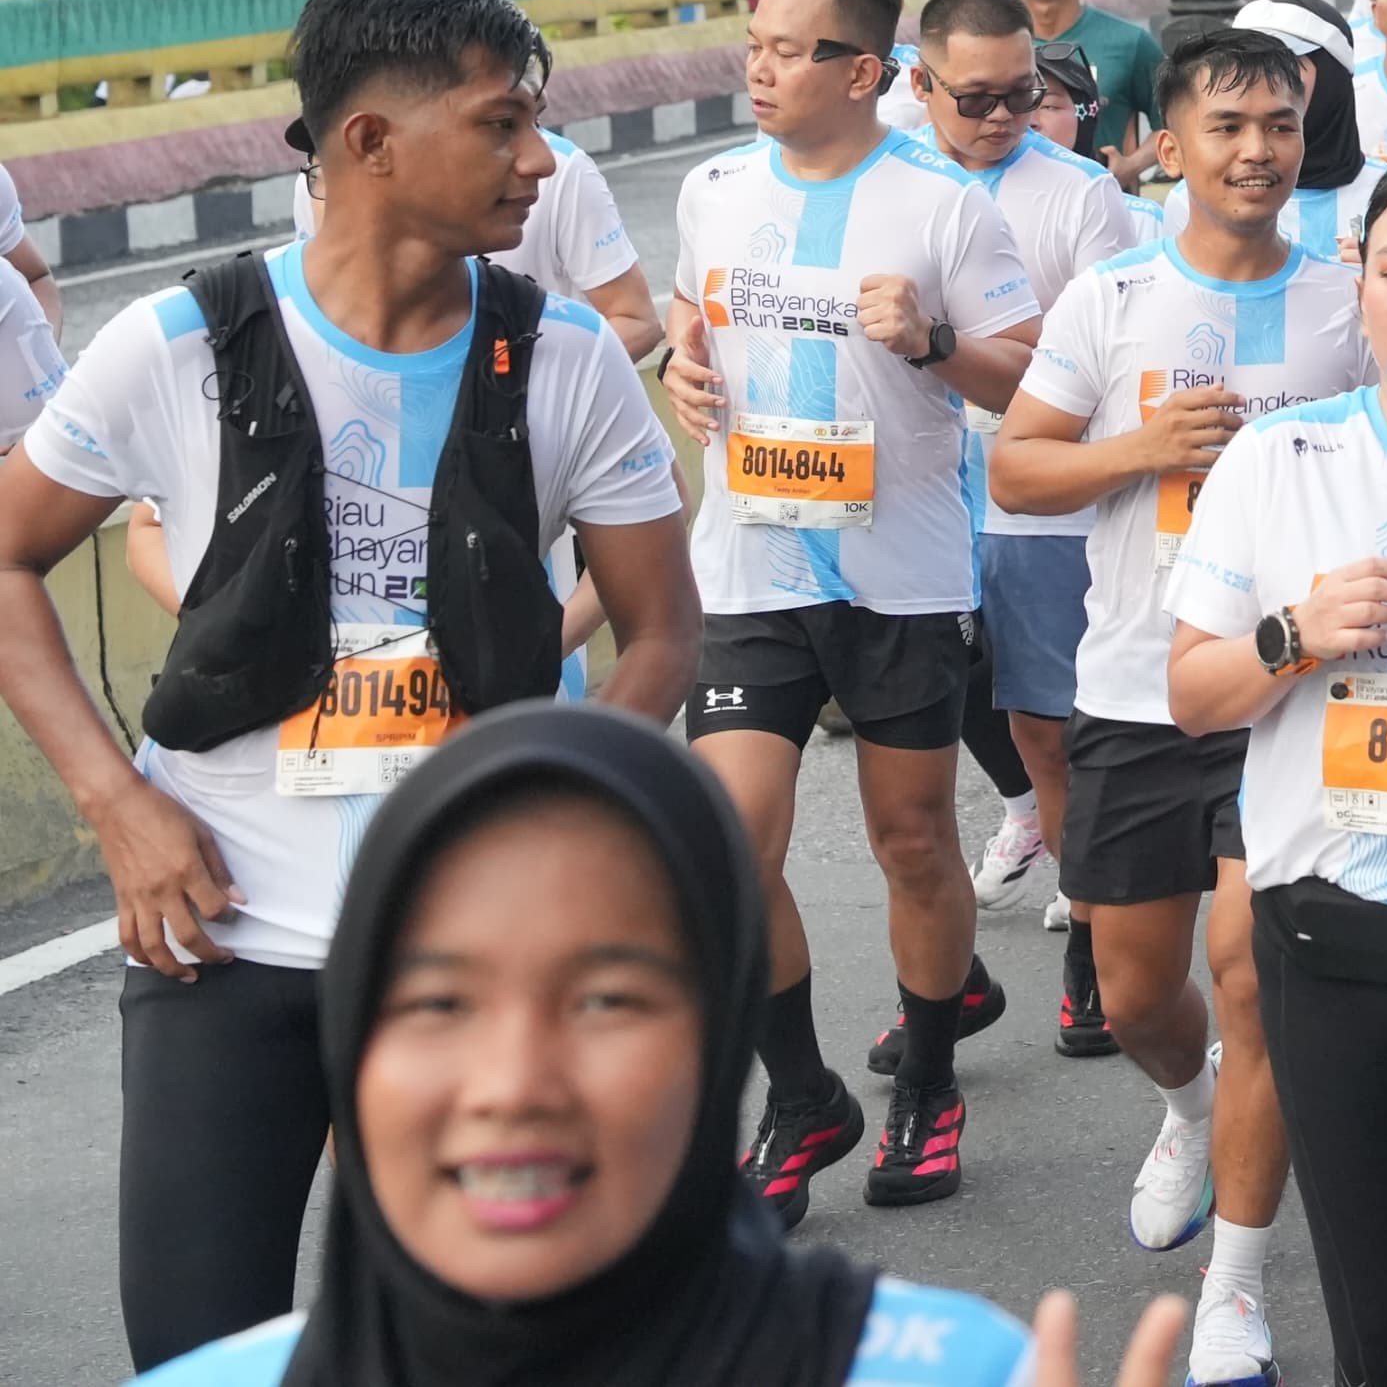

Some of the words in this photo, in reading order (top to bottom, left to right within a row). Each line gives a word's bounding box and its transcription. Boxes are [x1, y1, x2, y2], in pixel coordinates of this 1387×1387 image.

[909, 148, 951, 170] 10K
[731, 267, 781, 289] Riau
[731, 288, 859, 319] Bhayangka
[733, 309, 778, 329] Run
[782, 315, 849, 336] 2026
[742, 444, 846, 483] 8014844
[227, 473, 278, 524] SALOMON
[844, 502, 869, 513] 10K
[330, 571, 376, 596] un
[384, 576, 428, 600] 20
[321, 669, 456, 718] 801494
